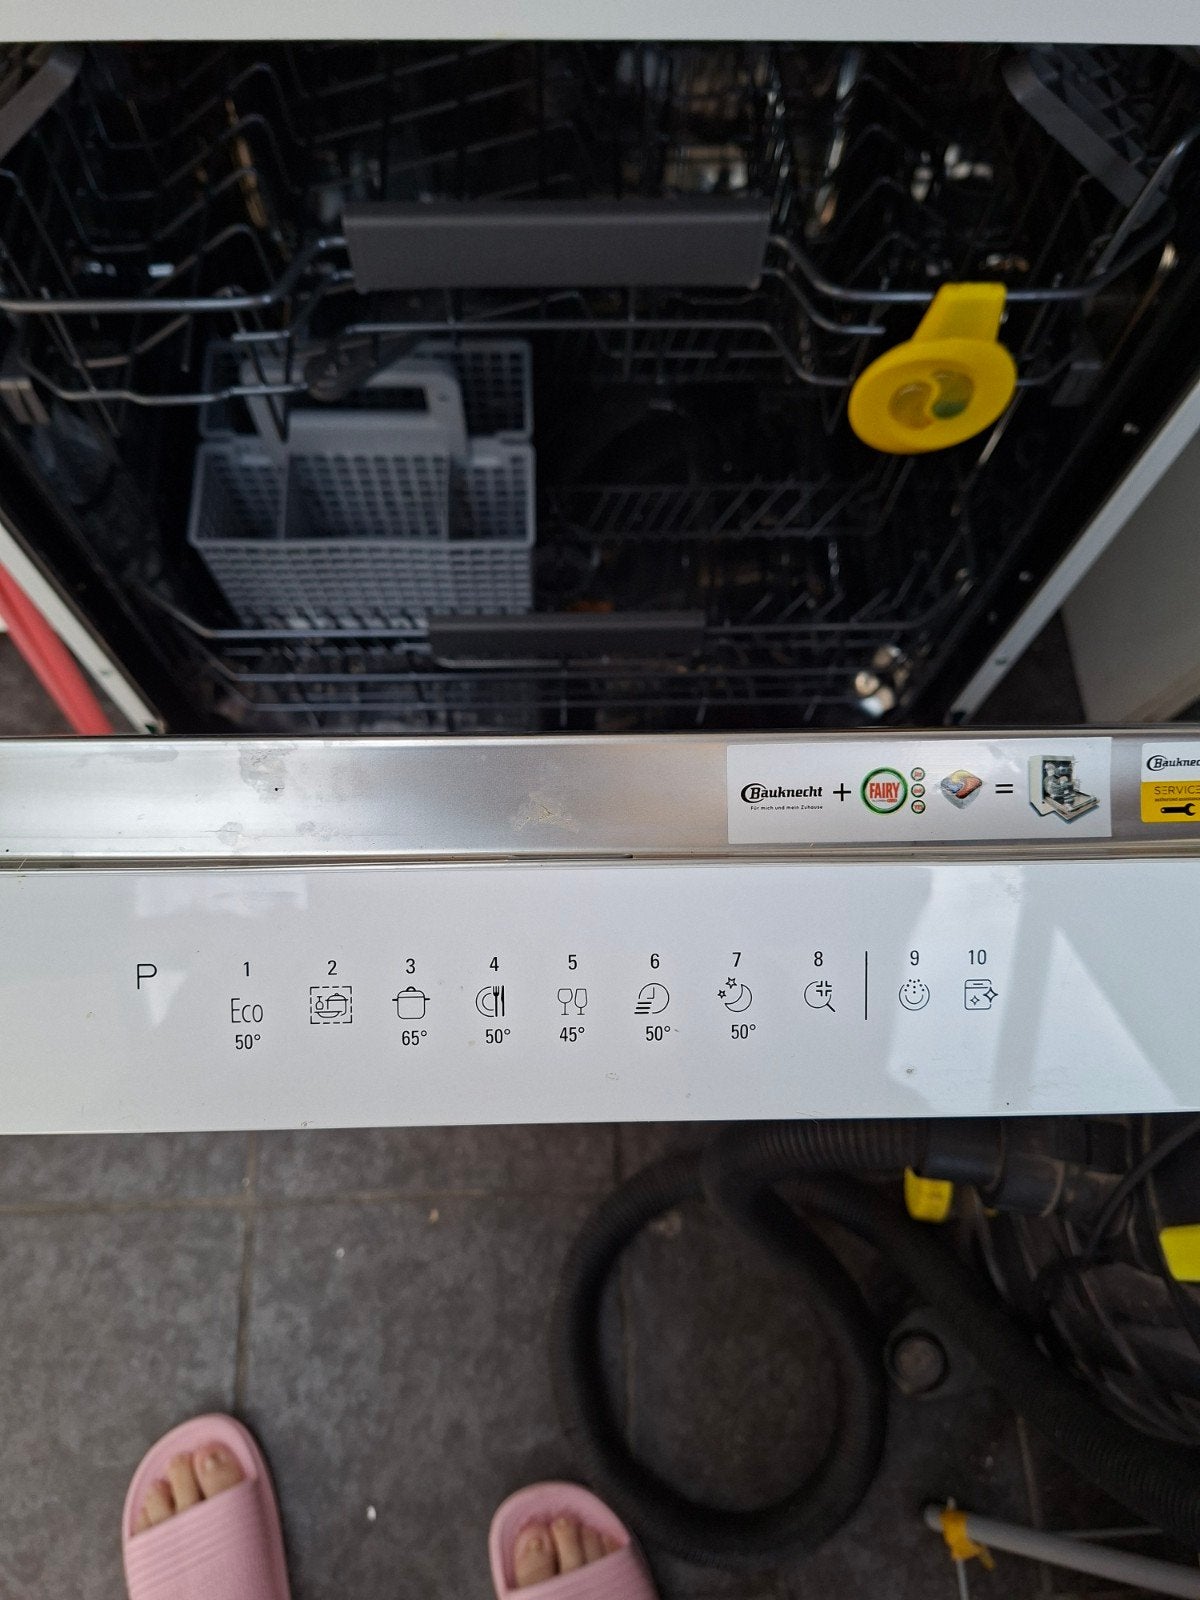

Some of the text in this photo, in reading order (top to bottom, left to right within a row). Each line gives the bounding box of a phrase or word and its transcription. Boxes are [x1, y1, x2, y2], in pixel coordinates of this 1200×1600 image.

[741, 783, 823, 803] Bauknecht
[869, 782, 900, 799] FAIRY
[1154, 785, 1200, 795] SERVICE
[489, 956, 500, 972] 4
[568, 954, 578, 971] 5
[650, 953, 660, 970] 6
[731, 952, 742, 968] 7
[813, 951, 824, 968] 8
[909, 950, 920, 967] 9
[968, 949, 987, 966] 10
[243, 961, 250, 977] 1
[327, 960, 338, 976] 2
[405, 958, 416, 975] 3
[137, 964, 158, 990] P
[230, 997, 264, 1024] Eco
[401, 1030, 428, 1047] 65°
[485, 1028, 511, 1045] 50°
[559, 1026, 586, 1043] 45°
[645, 1025, 671, 1042] 50°
[730, 1023, 757, 1040] 50°
[235, 1034, 262, 1051] 50°
